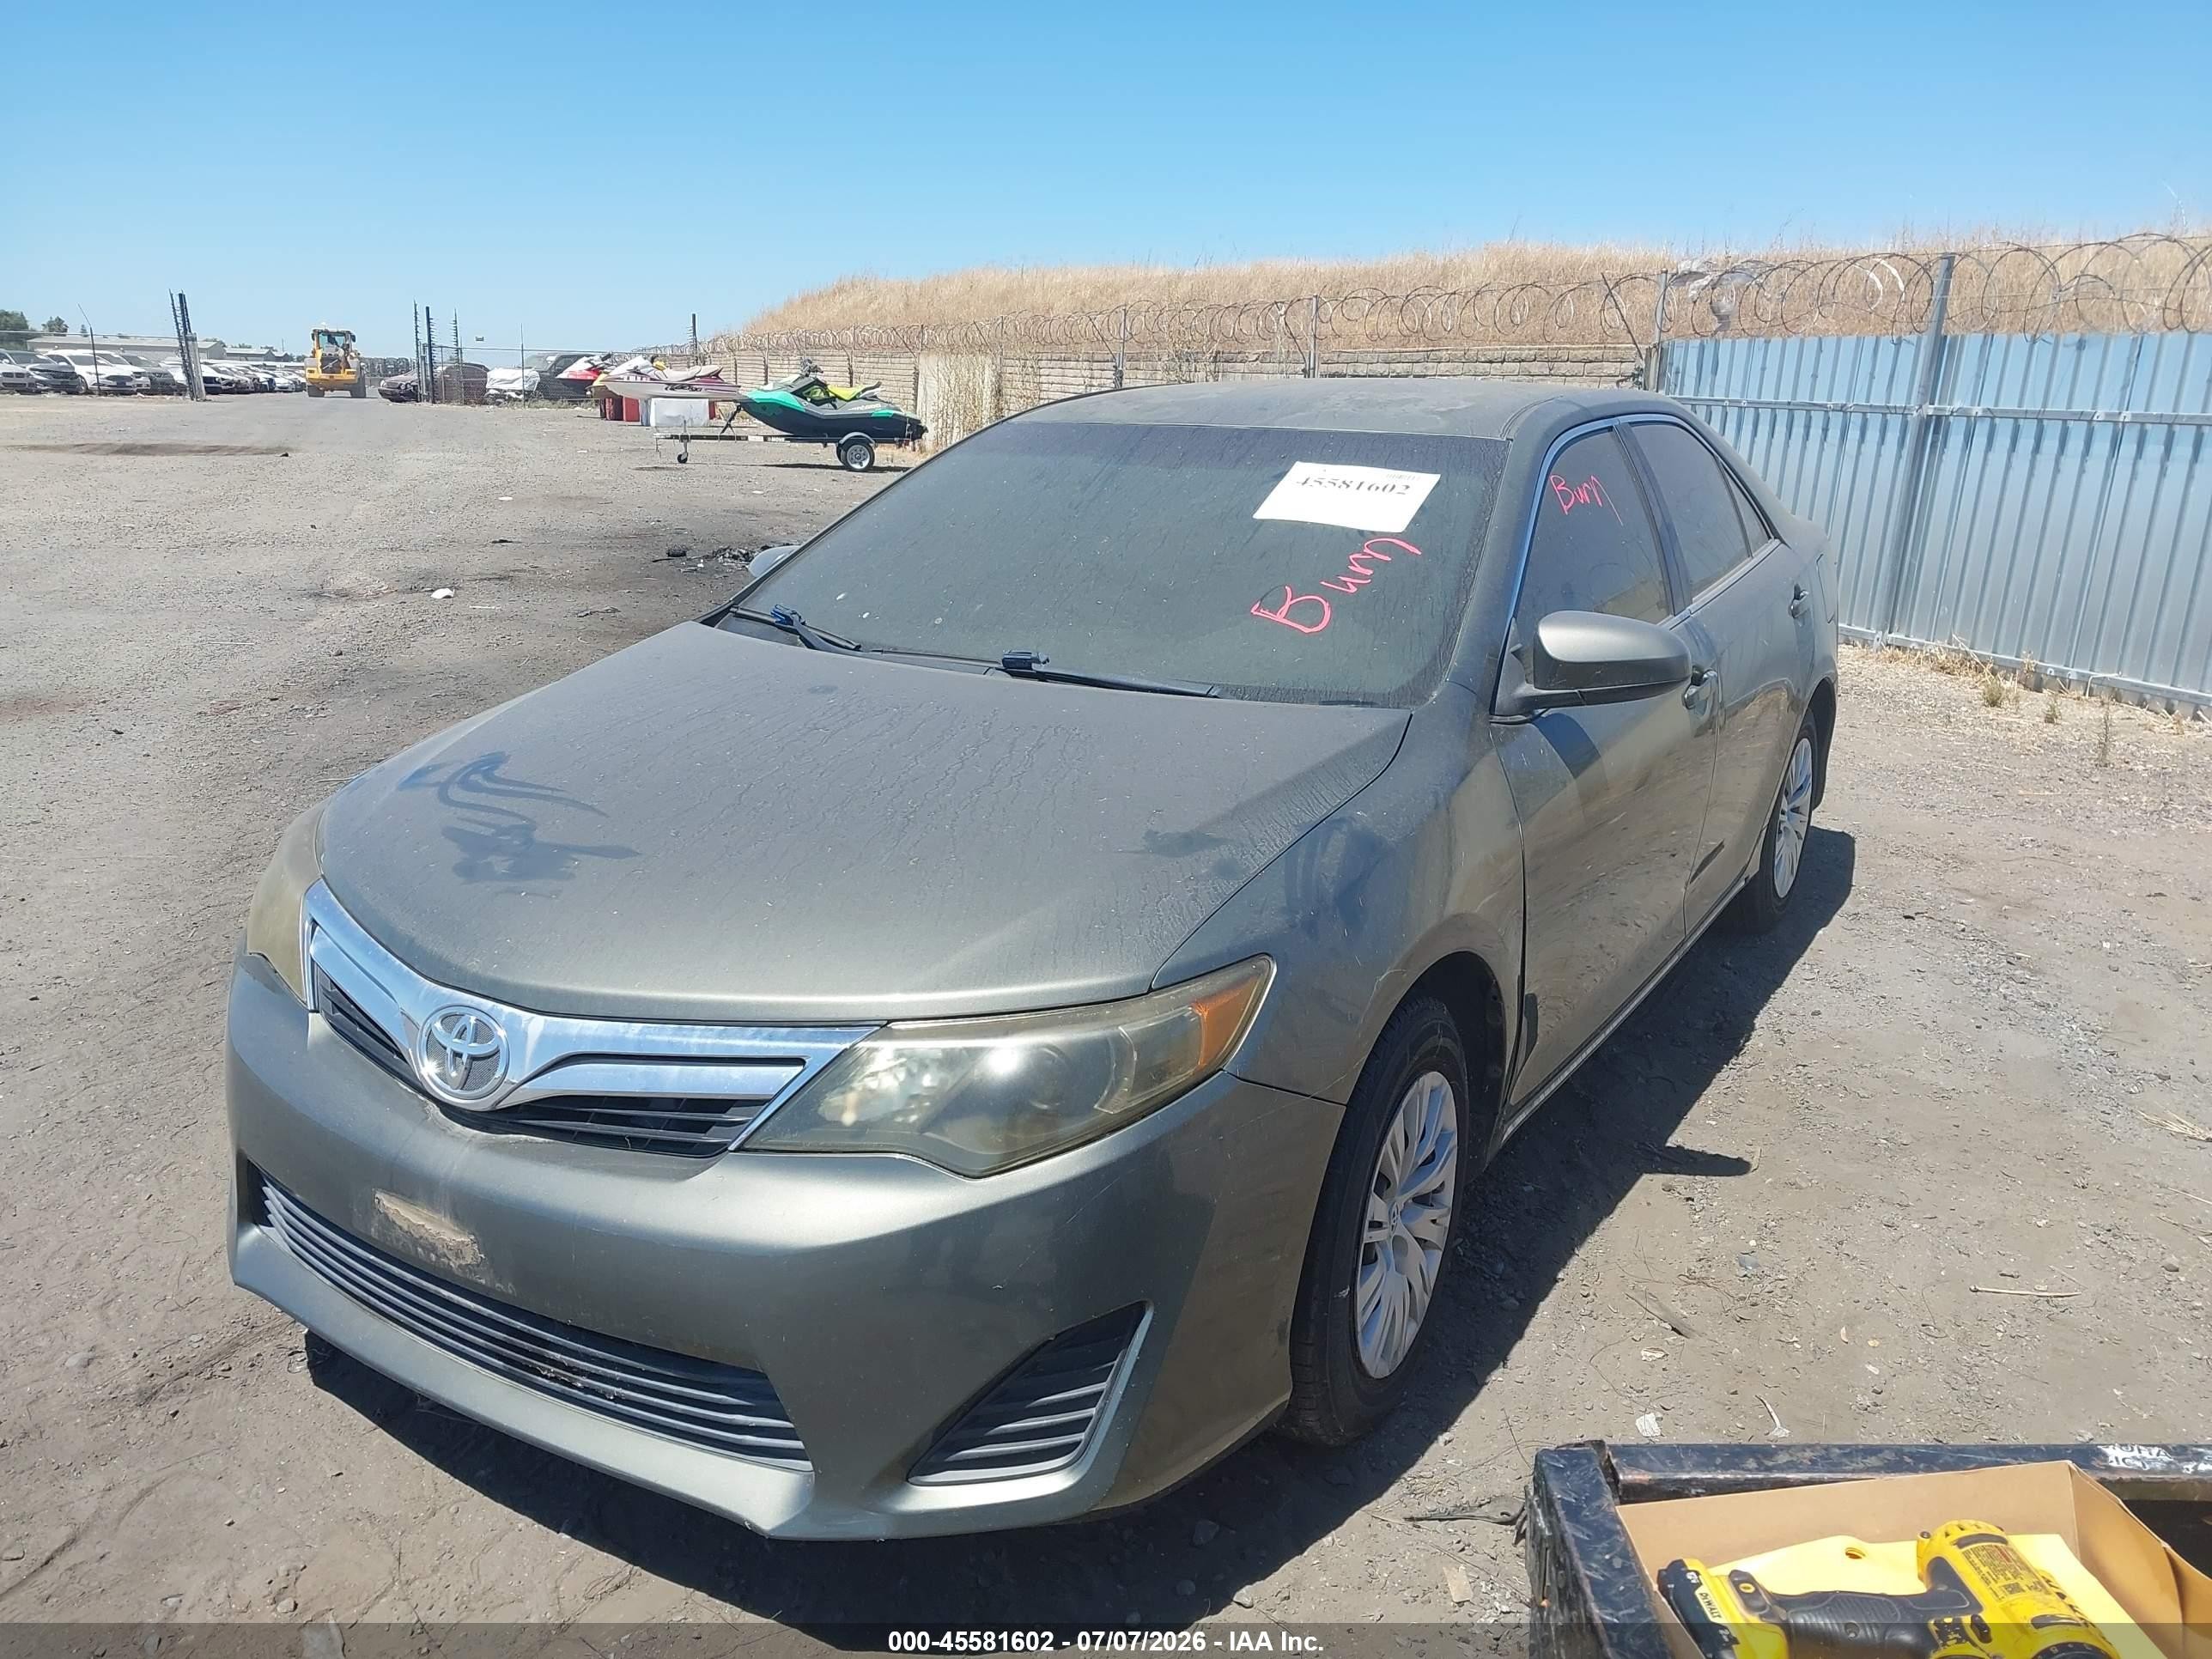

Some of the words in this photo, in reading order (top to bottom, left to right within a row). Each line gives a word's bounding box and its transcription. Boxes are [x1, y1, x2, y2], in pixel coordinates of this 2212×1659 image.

[1295, 475, 1411, 495] 45581602
[1549, 473, 1623, 526] Burn
[1251, 537, 1422, 634] Burn
